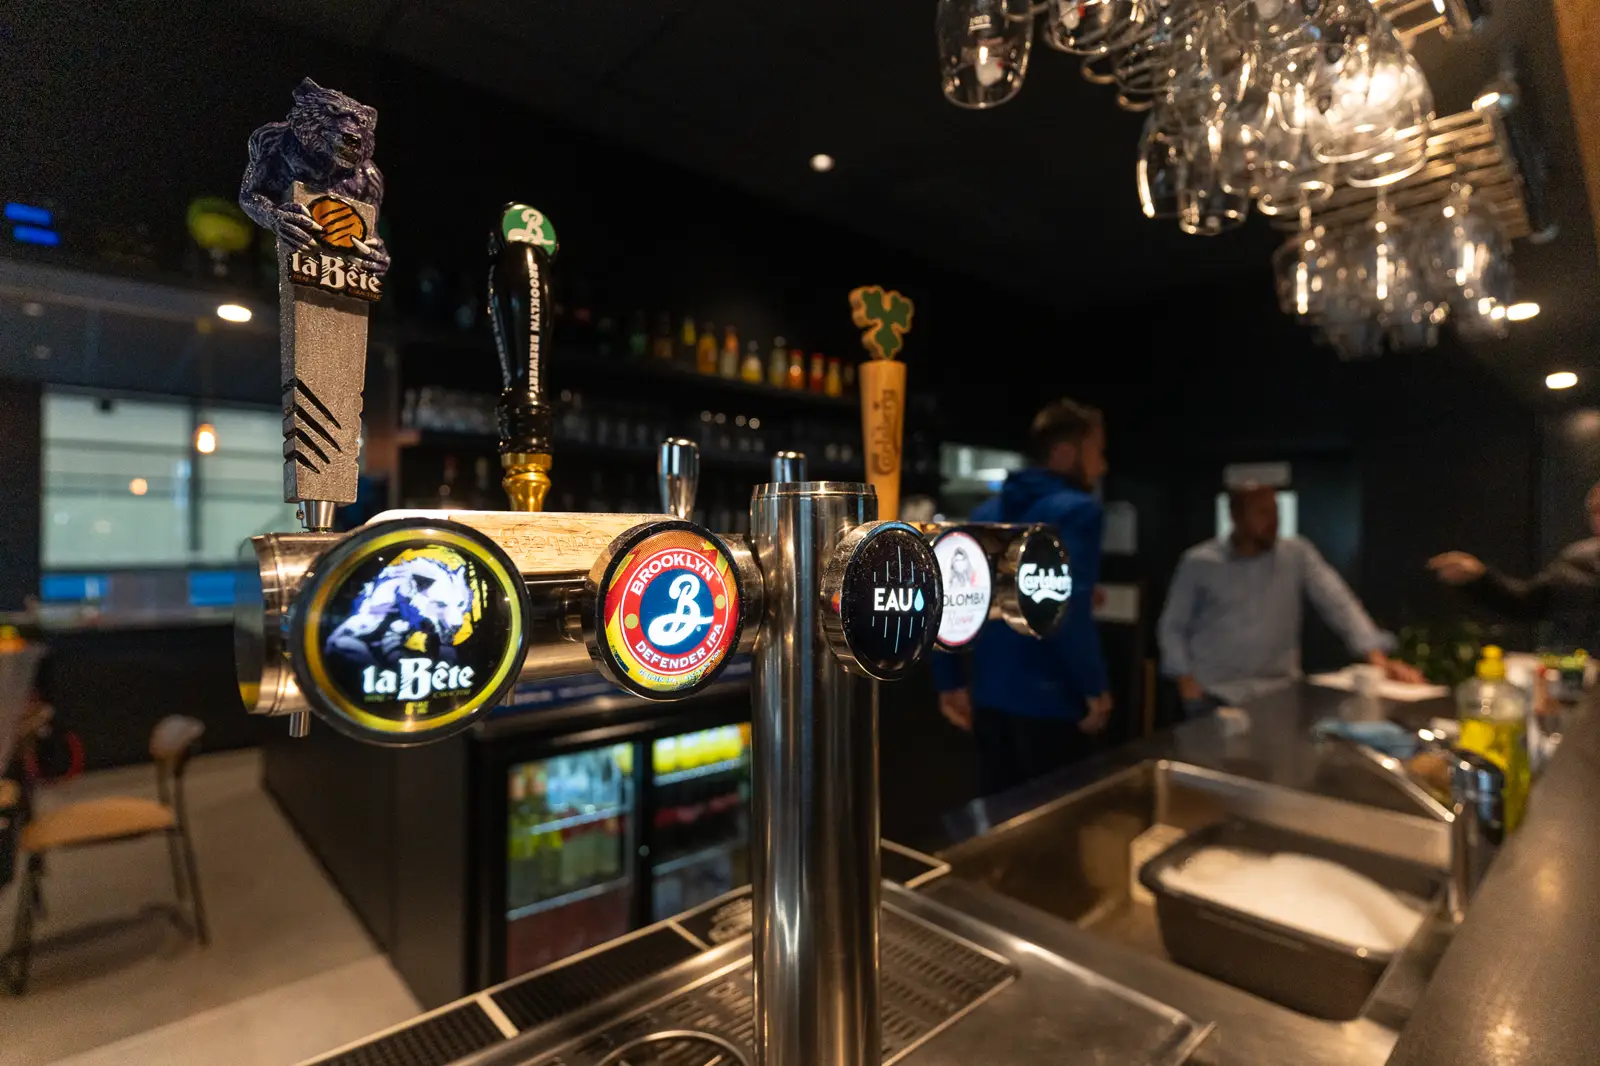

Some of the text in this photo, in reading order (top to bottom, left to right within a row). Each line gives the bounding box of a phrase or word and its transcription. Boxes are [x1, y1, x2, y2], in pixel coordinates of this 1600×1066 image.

[528, 261, 541, 393] BROOKLYN BREWERY
[630, 553, 715, 596] BROOKLYN
[873, 587, 914, 611] EAU
[943, 592, 986, 607] OLOMBA
[635, 623, 723, 669] DEFENDER IPA
[363, 657, 475, 700] la Bête
